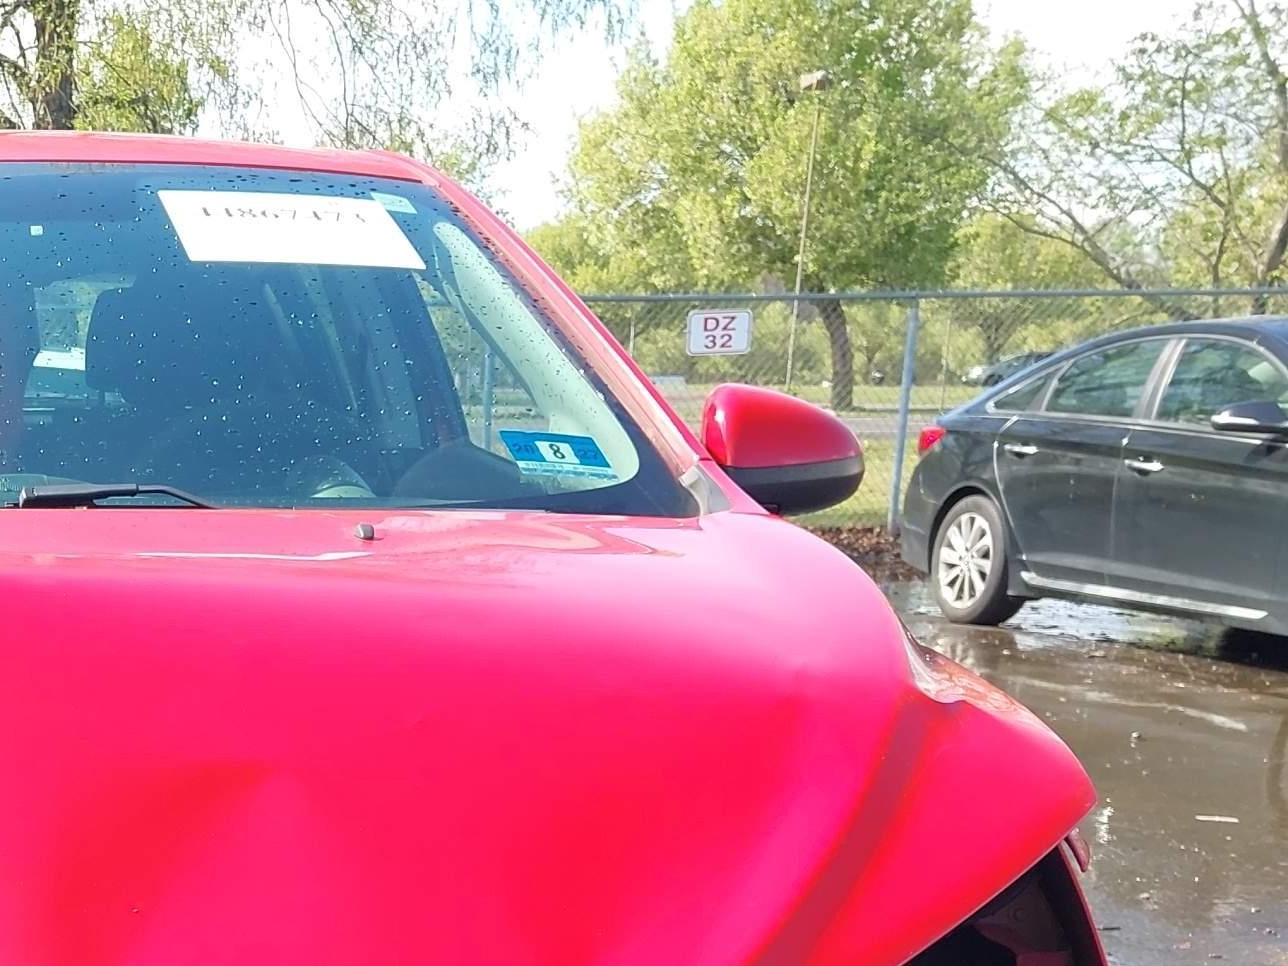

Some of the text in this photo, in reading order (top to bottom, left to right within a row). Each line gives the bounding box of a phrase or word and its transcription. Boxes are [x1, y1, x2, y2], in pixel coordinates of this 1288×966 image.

[704, 316, 737, 331] DZ
[704, 334, 733, 349] 32
[549, 443, 566, 460] 8
